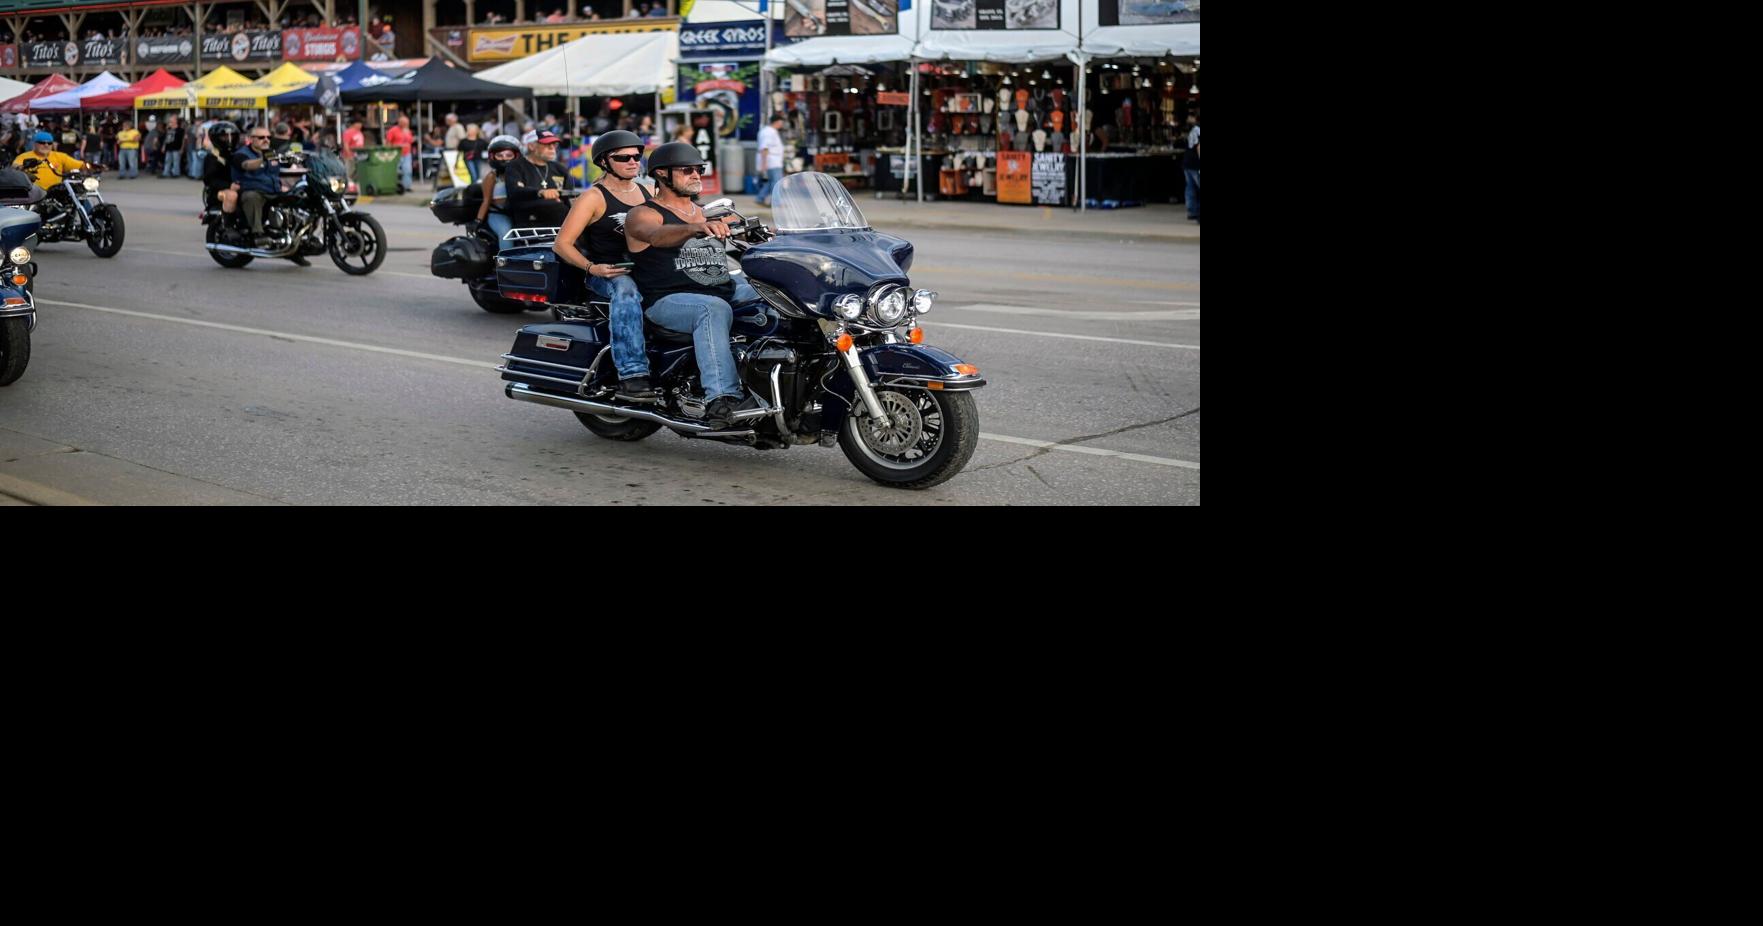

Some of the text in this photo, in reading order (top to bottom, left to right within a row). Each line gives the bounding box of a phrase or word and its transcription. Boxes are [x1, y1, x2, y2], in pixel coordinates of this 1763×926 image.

[252, 34, 281, 51] Tito's
[521, 31, 571, 53] THE
[680, 30, 720, 44] GREEK
[722, 26, 765, 43] GYROS
[33, 43, 60, 60] Tito's
[85, 39, 115, 58] Tito's
[203, 37, 229, 53] Tito's
[206, 98, 221, 106] KEEP
[1034, 152, 1064, 163] SANITY
